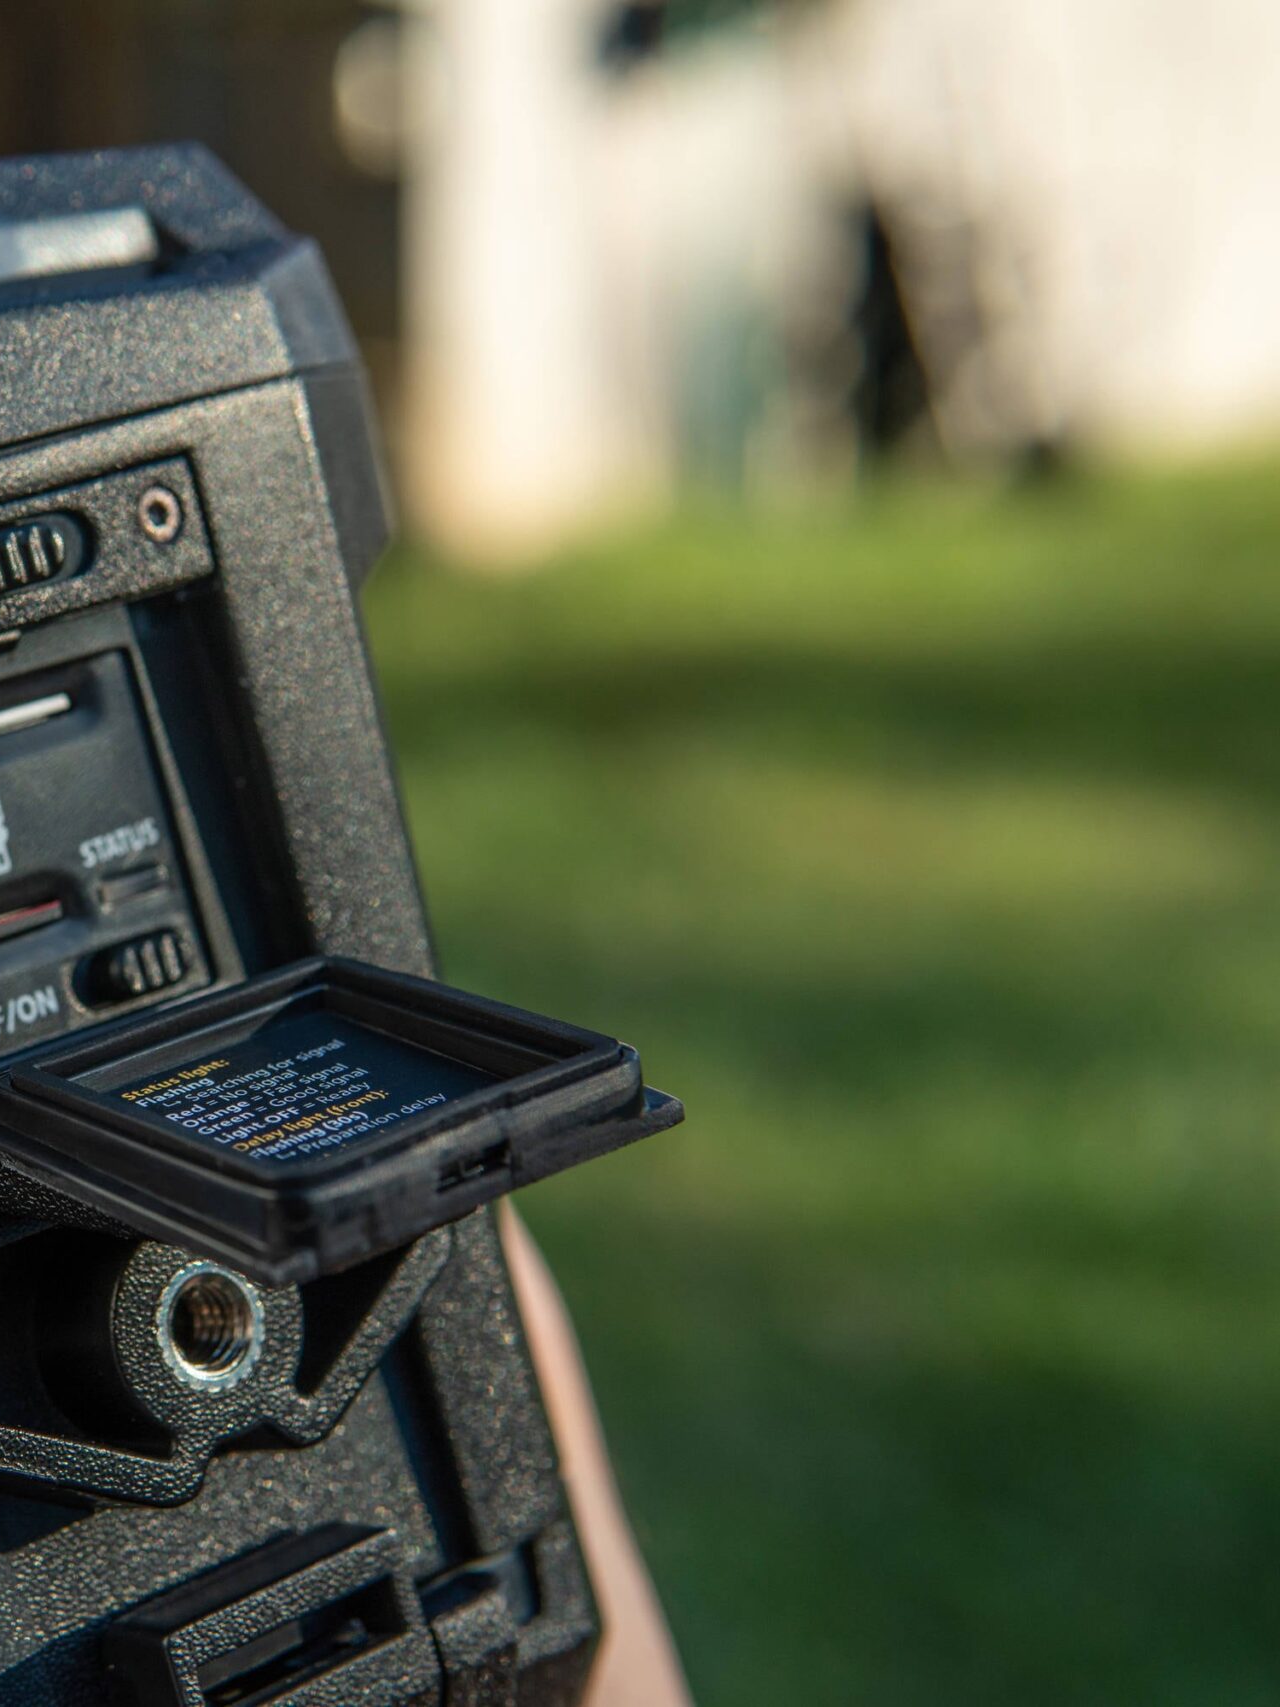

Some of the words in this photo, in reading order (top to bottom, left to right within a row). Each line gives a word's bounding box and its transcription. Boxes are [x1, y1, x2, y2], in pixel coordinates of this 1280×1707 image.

[79, 815, 160, 868] STATUS
[121, 1076, 180, 1101] Status
[178, 1059, 231, 1080] light:
[135, 1078, 215, 1108] Flashing
[165, 1103, 207, 1122] Red
[219, 1089, 248, 1102] No
[249, 1068, 299, 1091] signal
[182, 1101, 251, 1128] Orange
[263, 1081, 298, 1097] Fair
[299, 1062, 349, 1085] signal
[185, 1068, 271, 1102] Searching
[267, 1059, 296, 1072] for
[296, 1038, 346, 1062] signal
[198, 1111, 256, 1135] Green
[269, 1086, 318, 1107] Good
[319, 1068, 369, 1090] signal
[213, 1121, 266, 1144] Light
[264, 1106, 300, 1124] OFF
[316, 1082, 371, 1105] Ready
[232, 1129, 285, 1152] Delay
[281, 1111, 330, 1132] light
[326, 1089, 390, 1116] (front):
[298, 1111, 401, 1154] Preparation
[400, 1092, 447, 1116] delay
[248, 1127, 327, 1160] Flashing
[322, 1110, 369, 1131] (30s)
